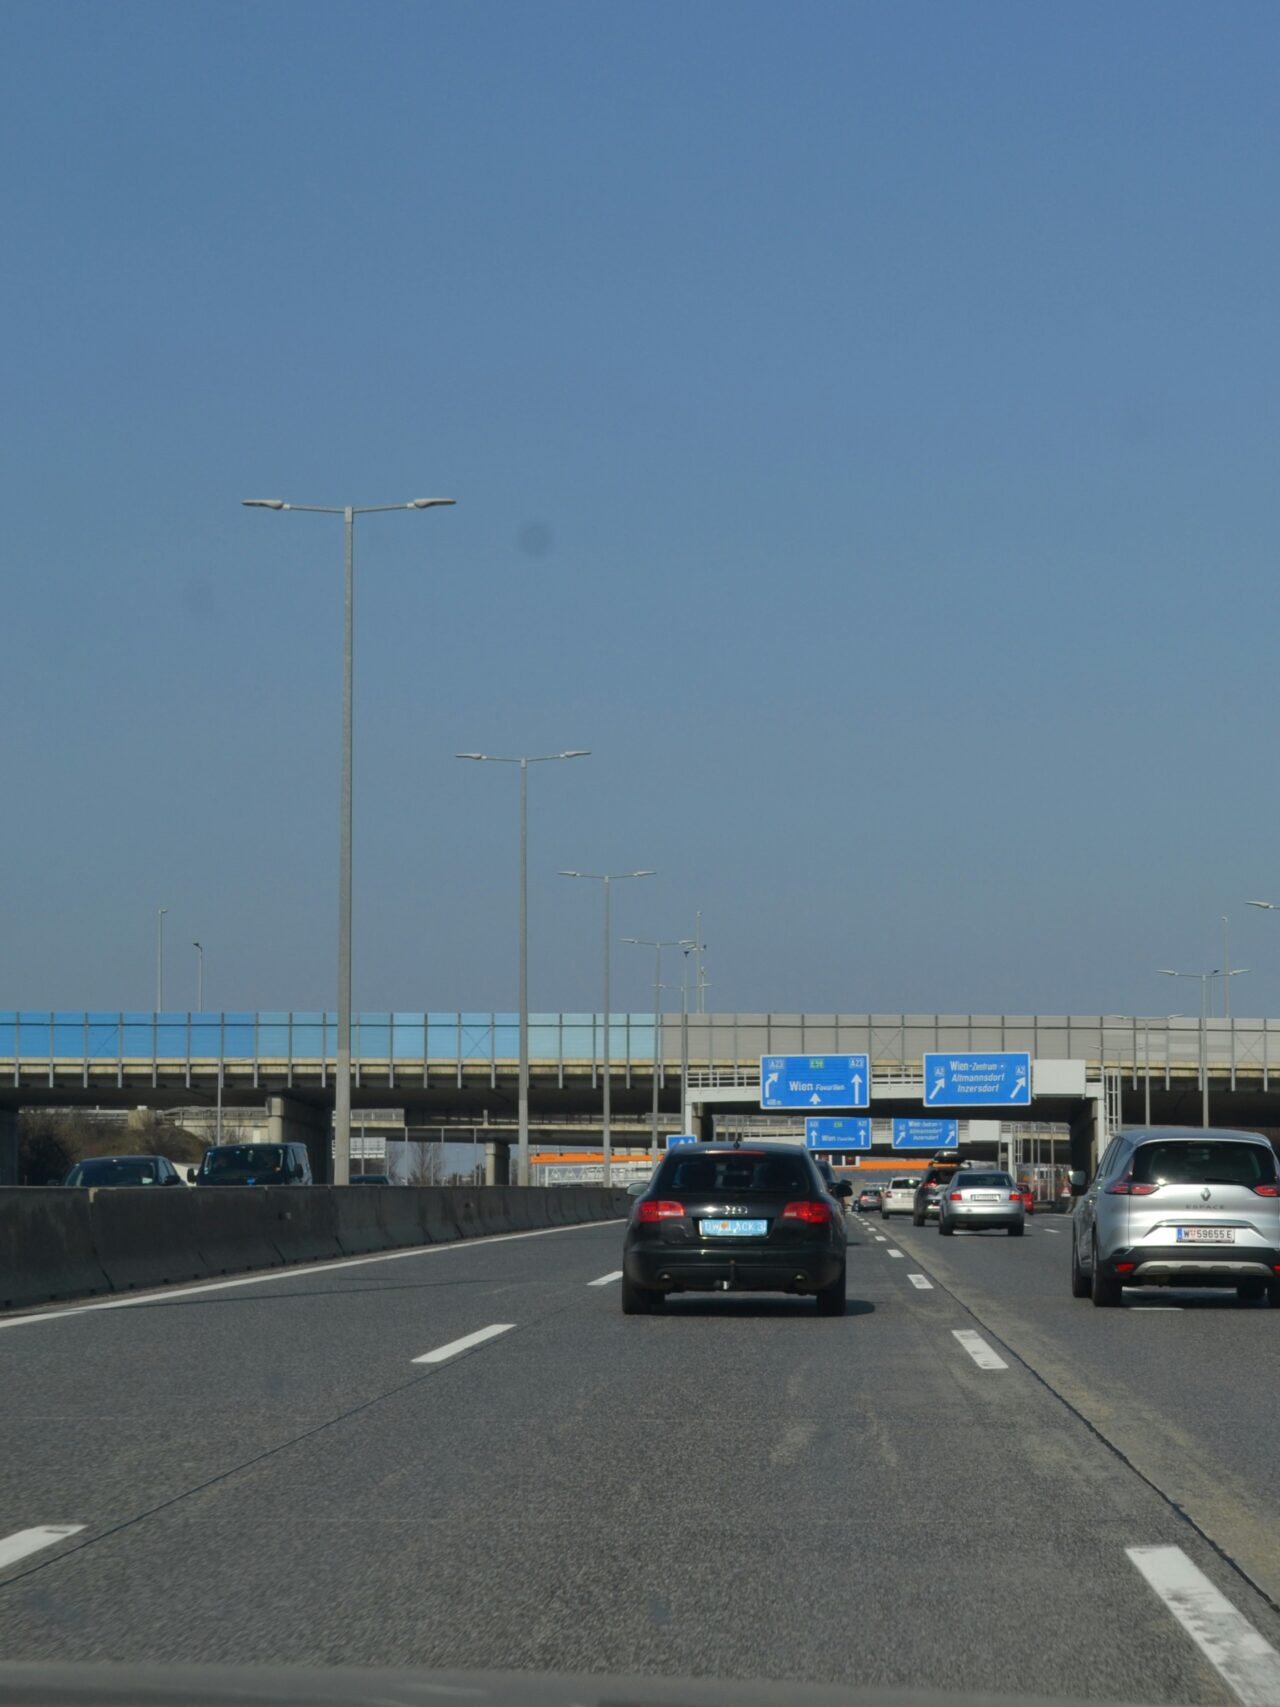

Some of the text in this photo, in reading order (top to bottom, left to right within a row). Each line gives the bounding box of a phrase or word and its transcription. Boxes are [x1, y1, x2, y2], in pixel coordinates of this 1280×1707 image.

[951, 1073, 1005, 1082] Altmannsdorf
[789, 1081, 813, 1091] Wien
[957, 1084, 999, 1093] Inzersdorf
